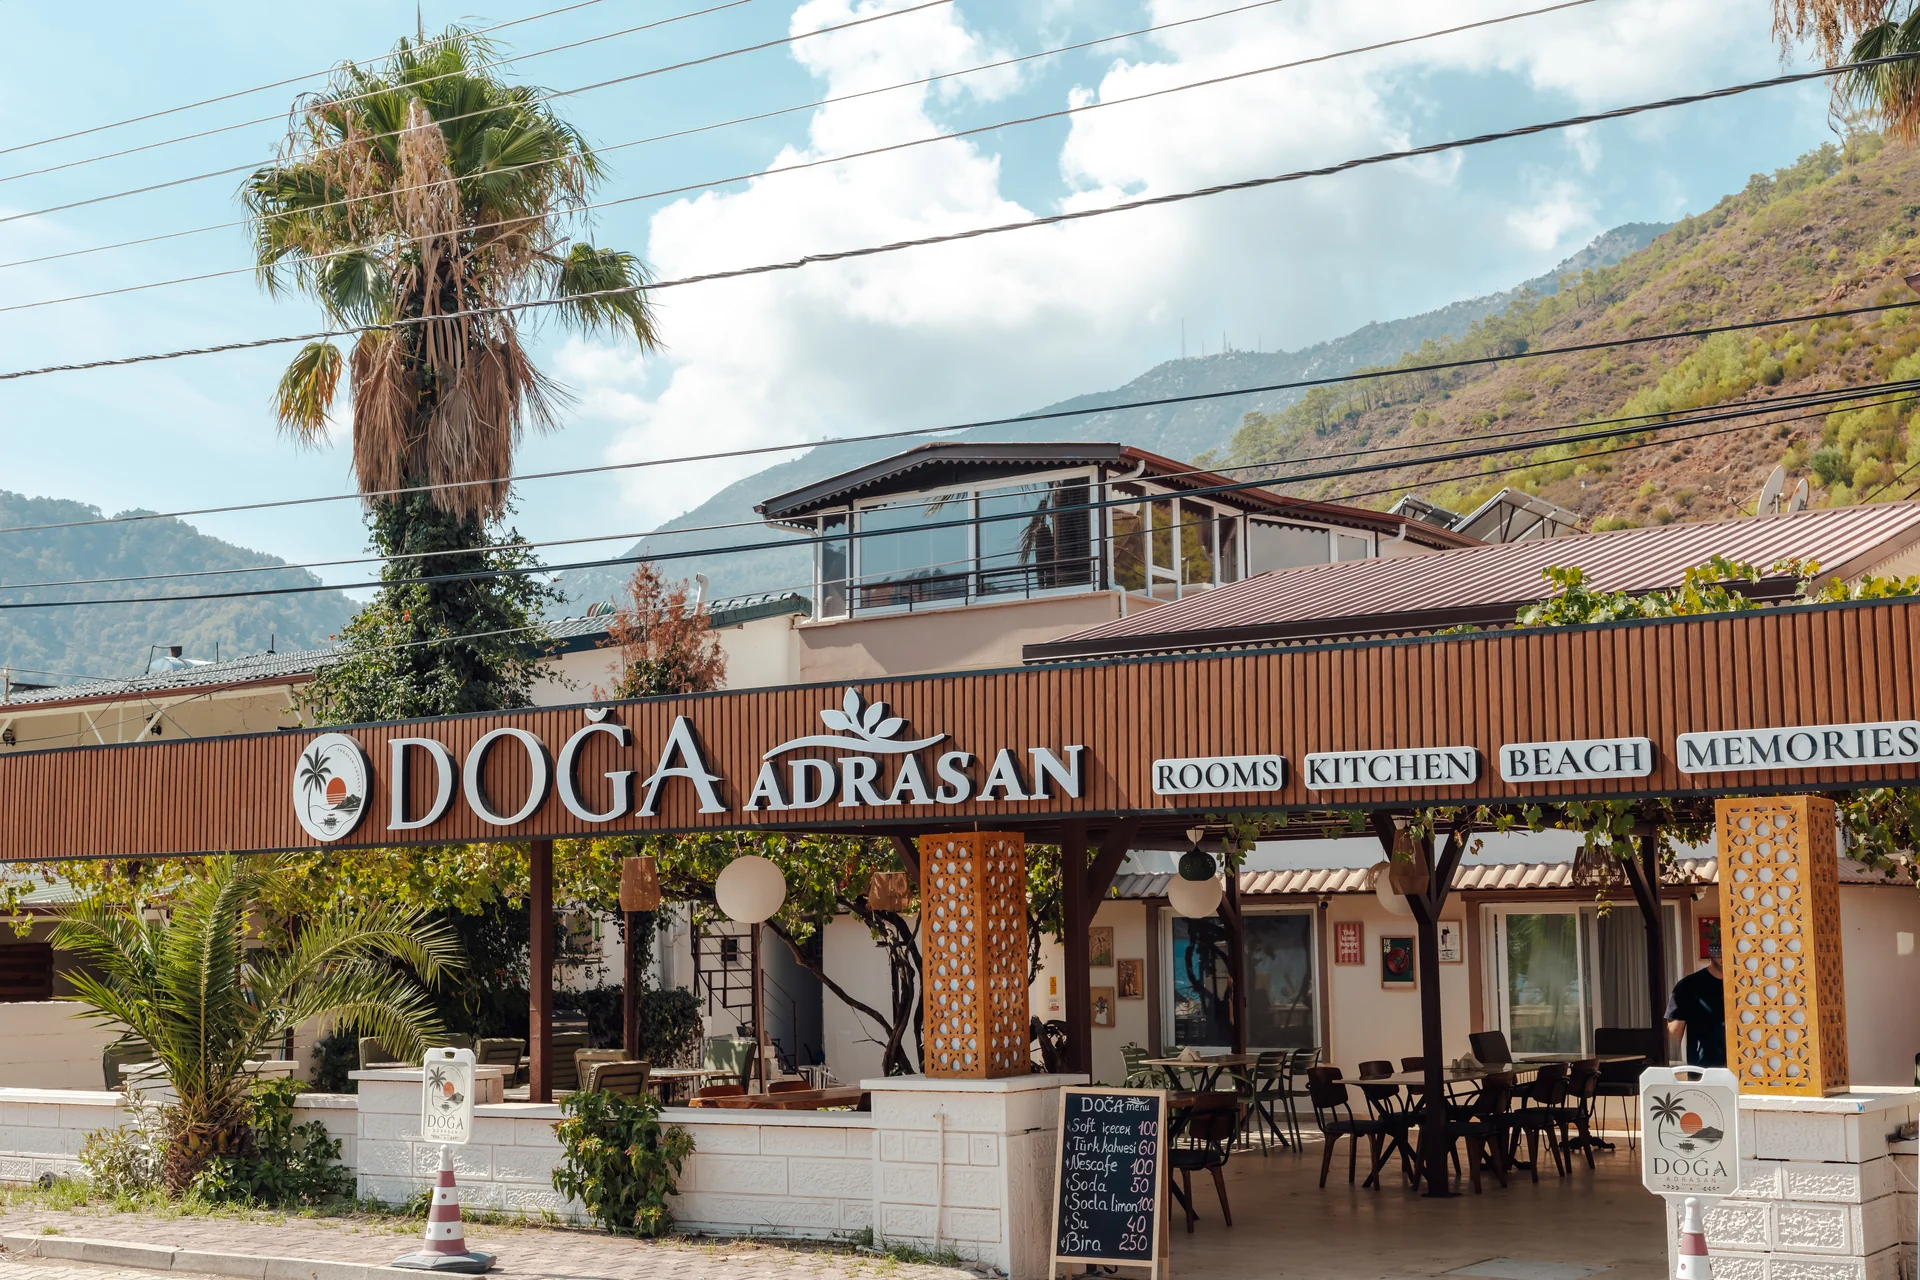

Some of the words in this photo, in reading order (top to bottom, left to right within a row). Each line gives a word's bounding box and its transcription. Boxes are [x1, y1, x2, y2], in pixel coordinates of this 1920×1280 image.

[1684, 726, 1919, 768] MEMORIES
[387, 708, 728, 831] DOĞA
[743, 744, 1085, 811] ADRASAN
[1308, 752, 1472, 784] KITCHEN
[1508, 742, 1644, 777] BEACH
[1157, 760, 1279, 791] ROOMS
[1081, 1096, 1124, 1113] DOĞA
[1126, 1102, 1150, 1111] menu
[427, 1114, 464, 1130] DOĞA
[1071, 1117, 1096, 1134] Soft
[1138, 1120, 1158, 1136] 100
[1073, 1136, 1100, 1152] Türk
[1101, 1135, 1137, 1154] kahvesi
[1138, 1139, 1156, 1155] 60
[1069, 1152, 1118, 1178] Nescafe
[1130, 1158, 1154, 1175] 100
[1653, 1157, 1728, 1177] DOĞA
[1070, 1172, 1107, 1192] Soda
[1130, 1176, 1149, 1193] 50
[1069, 1192, 1108, 1210] Soda
[1111, 1193, 1138, 1213] limon
[1137, 1196, 1155, 1212] 100
[1070, 1211, 1089, 1230] Su
[1127, 1215, 1146, 1233] 40
[1063, 1231, 1102, 1254] Bira
[1119, 1233, 1148, 1251] 250
